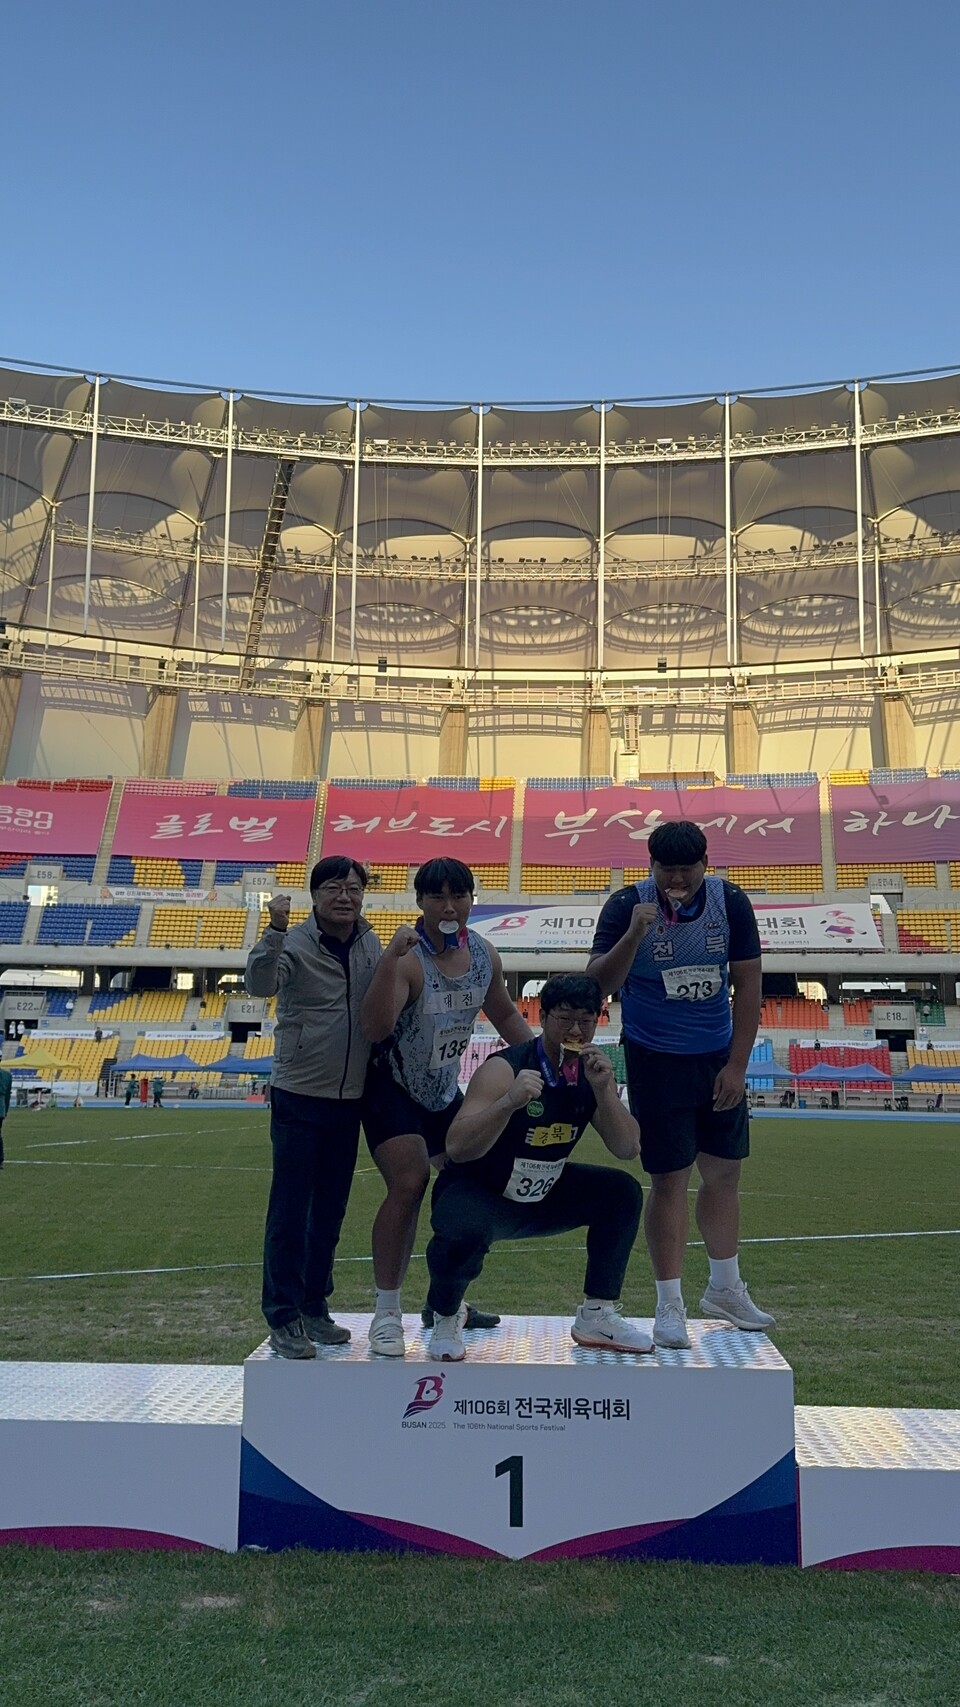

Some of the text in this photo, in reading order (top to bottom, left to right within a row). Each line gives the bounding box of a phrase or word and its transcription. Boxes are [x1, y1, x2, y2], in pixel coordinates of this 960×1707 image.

[149, 812, 278, 842] 글로벌
[330, 811, 508, 838] 허브도시
[842, 804, 960, 836] 하나
[37, 871, 53, 879] E58
[252, 877, 267, 885] E57
[676, 980, 713, 999] 273
[16, 1001, 34, 1011] E22
[241, 1004, 256, 1013] E21
[886, 1011, 902, 1021] E18
[439, 1038, 468, 1061] 138
[539, 1126, 565, 1145] 경북
[516, 1177, 555, 1197] 326
[453, 1396, 631, 1421] 제106회 전국체육대회
[401, 1421, 446, 1430] BUSAN 2025
[466, 1422, 486, 1431] 106th
[487, 1423, 515, 1431] National
[516, 1423, 539, 1433] Sports
[539, 1423, 566, 1432] Festival
[495, 1455, 523, 1527] 1
